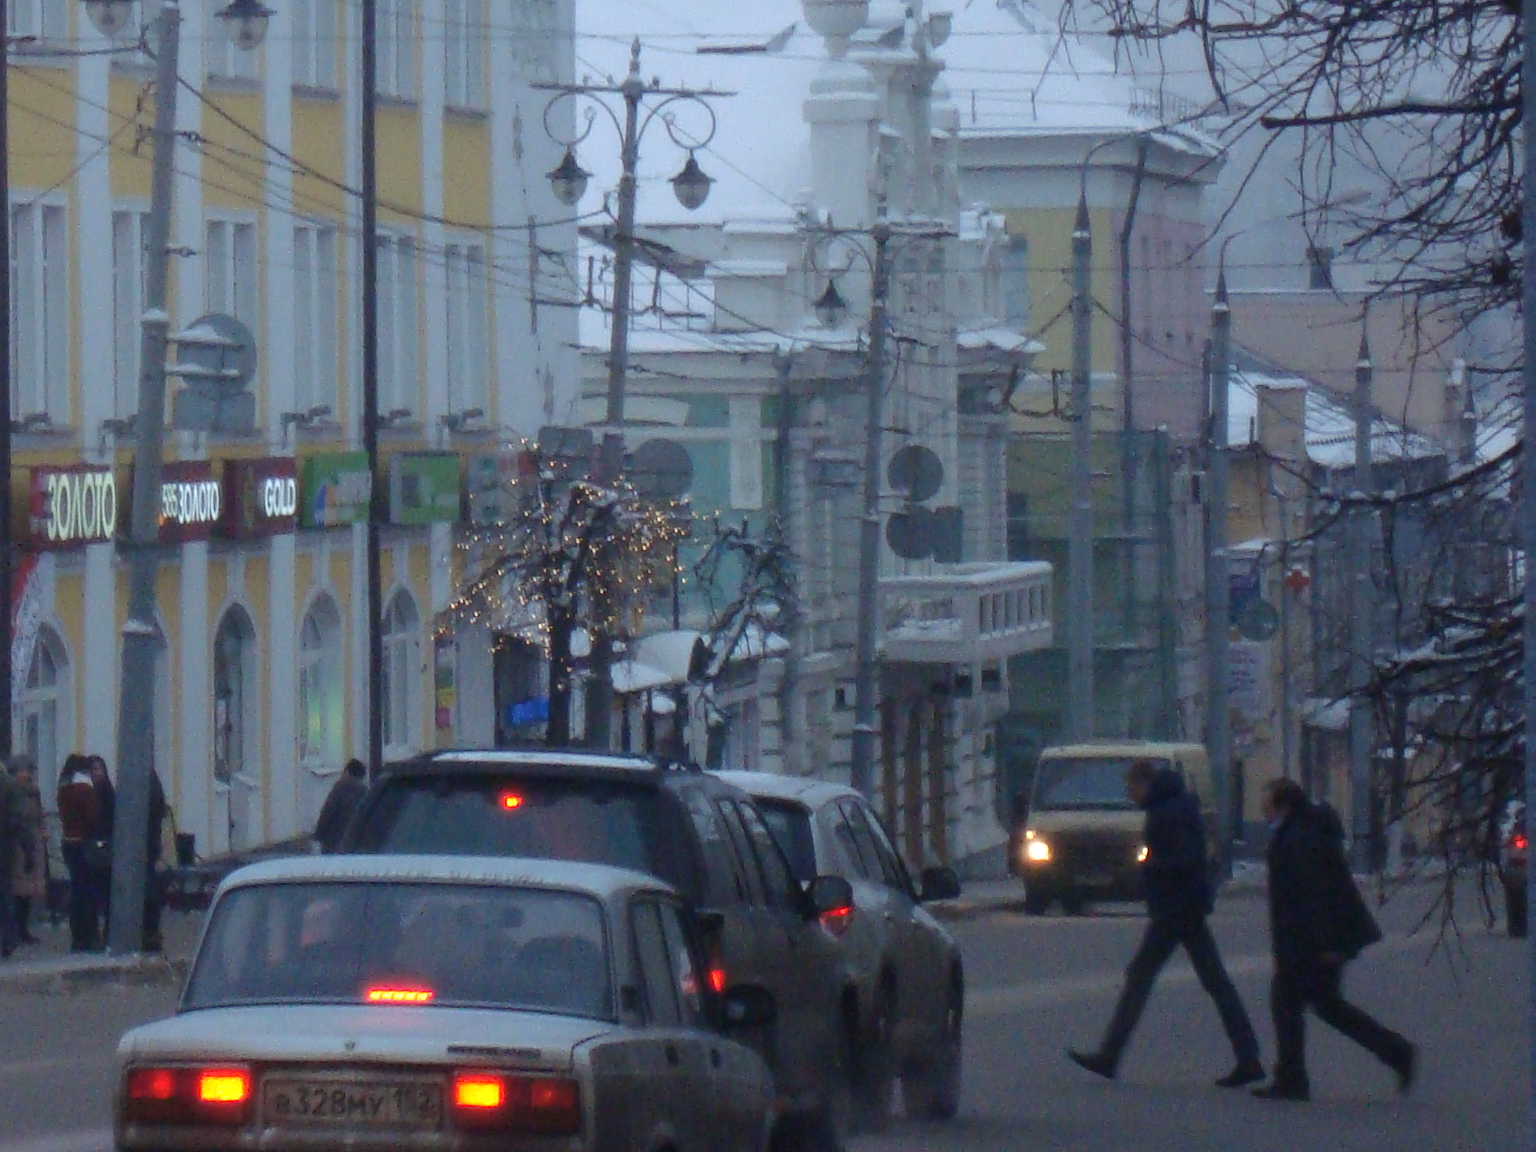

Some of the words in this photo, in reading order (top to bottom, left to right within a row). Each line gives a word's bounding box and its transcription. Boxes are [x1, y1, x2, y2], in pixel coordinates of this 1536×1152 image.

[47, 472, 114, 541] ЗОЛОТО
[178, 481, 220, 524] ЗОЛОТО
[264, 477, 296, 517] GOLD
